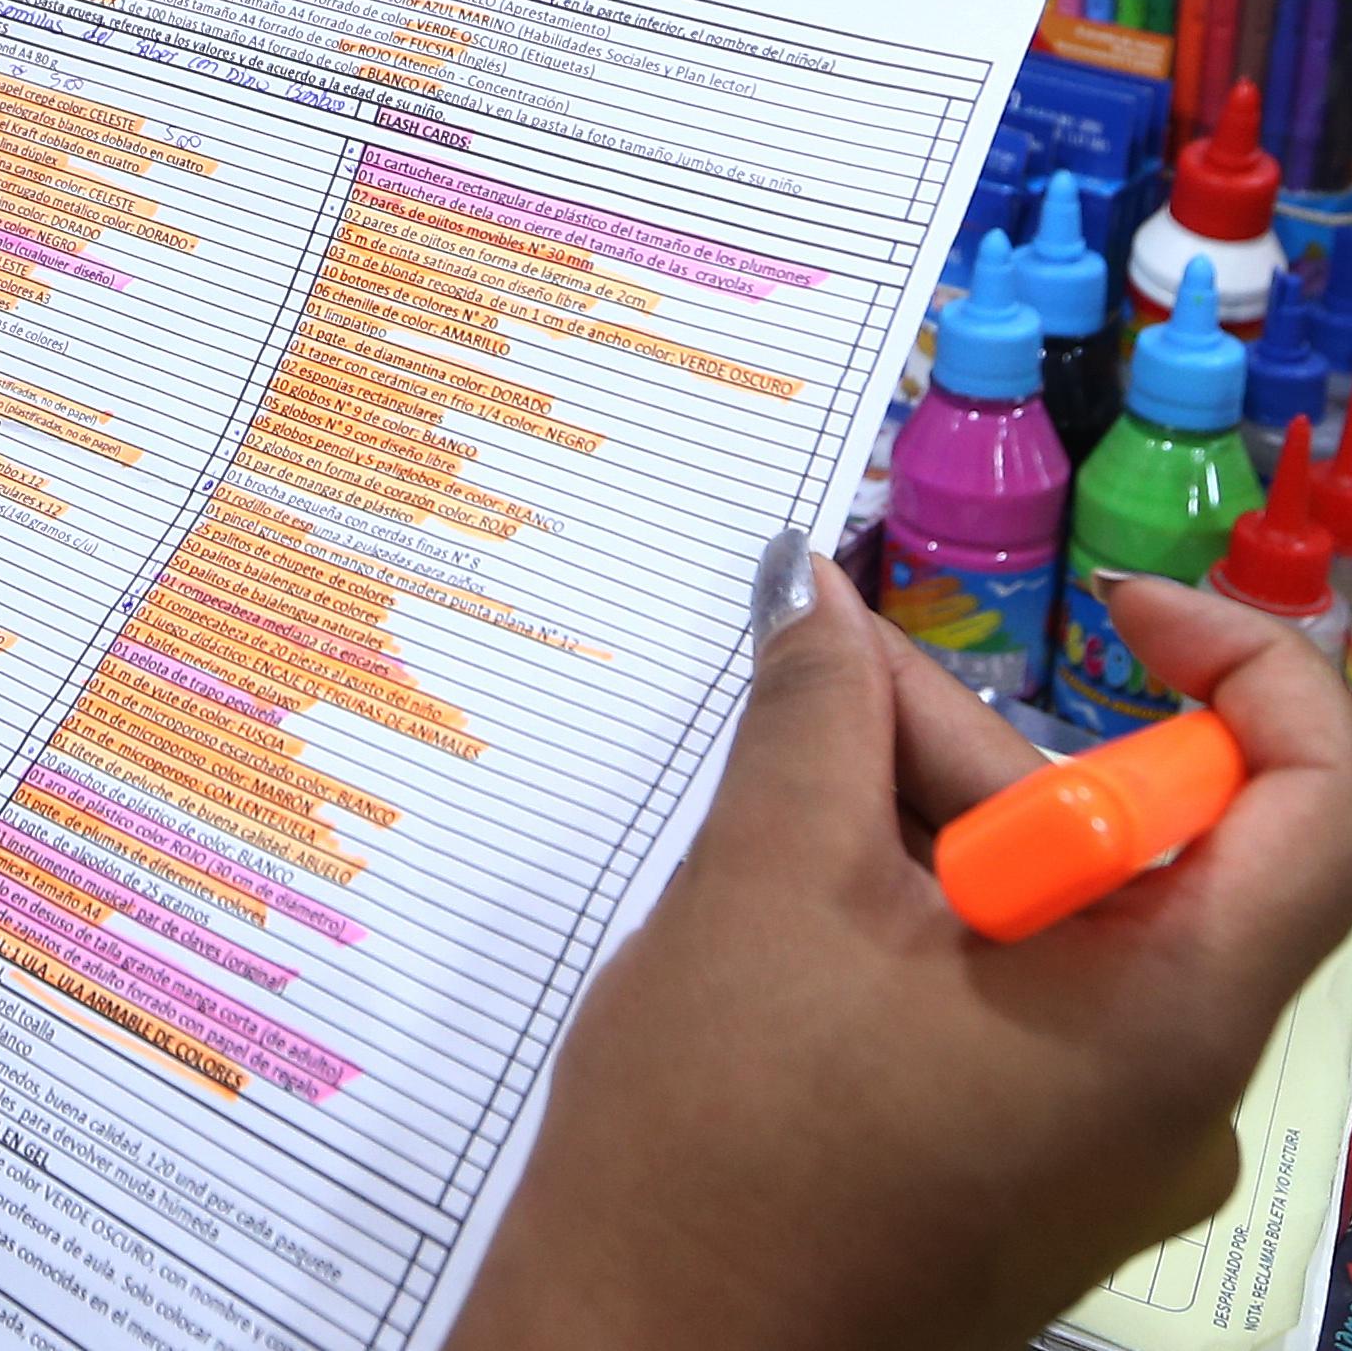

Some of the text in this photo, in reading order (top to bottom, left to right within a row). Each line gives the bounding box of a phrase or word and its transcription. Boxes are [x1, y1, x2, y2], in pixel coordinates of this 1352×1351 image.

[18, 46, 35, 60] A4
[34, 51, 51, 64] 80
[26, 90, 59, 106] crepé
[58, 100, 90, 116] color:
[90, 108, 136, 130] CELESTE
[377, 112, 472, 148] FLASH CARDS:
[363, 150, 811, 285] 01 cartuchera rectangular de plástico del tamaño de los plumones
[303, 301, 388, 337] 01 limpiatipo
[311, 282, 512, 355] 06 chenille de color: AMARILLO
[262, 395, 283, 410] 05
[280, 403, 325, 426] globos
[325, 417, 345, 430] N°
[355, 430, 381, 445] con
[380, 435, 425, 460] diseño
[425, 451, 456, 471] libre
[31, 873, 82, 909] tamaño
[80, 900, 102, 919] A4
[18, 1009, 55, 1040] toalla
[26, 956, 58, 981] ULA
[63, 978, 95, 1003] ULA
[92, 994, 160, 1041] ARMABLE
[158, 1033, 181, 1053] DE
[178, 1044, 243, 1089] COLORES
[2, 1128, 27, 1151] EN
[22, 1141, 53, 1167] GEL
[1245, 1128, 1301, 1331] NOTA: RECLAMAR BOLETA Y/O FACTURA
[1214, 1244, 1244, 1330] DESPACHADO
